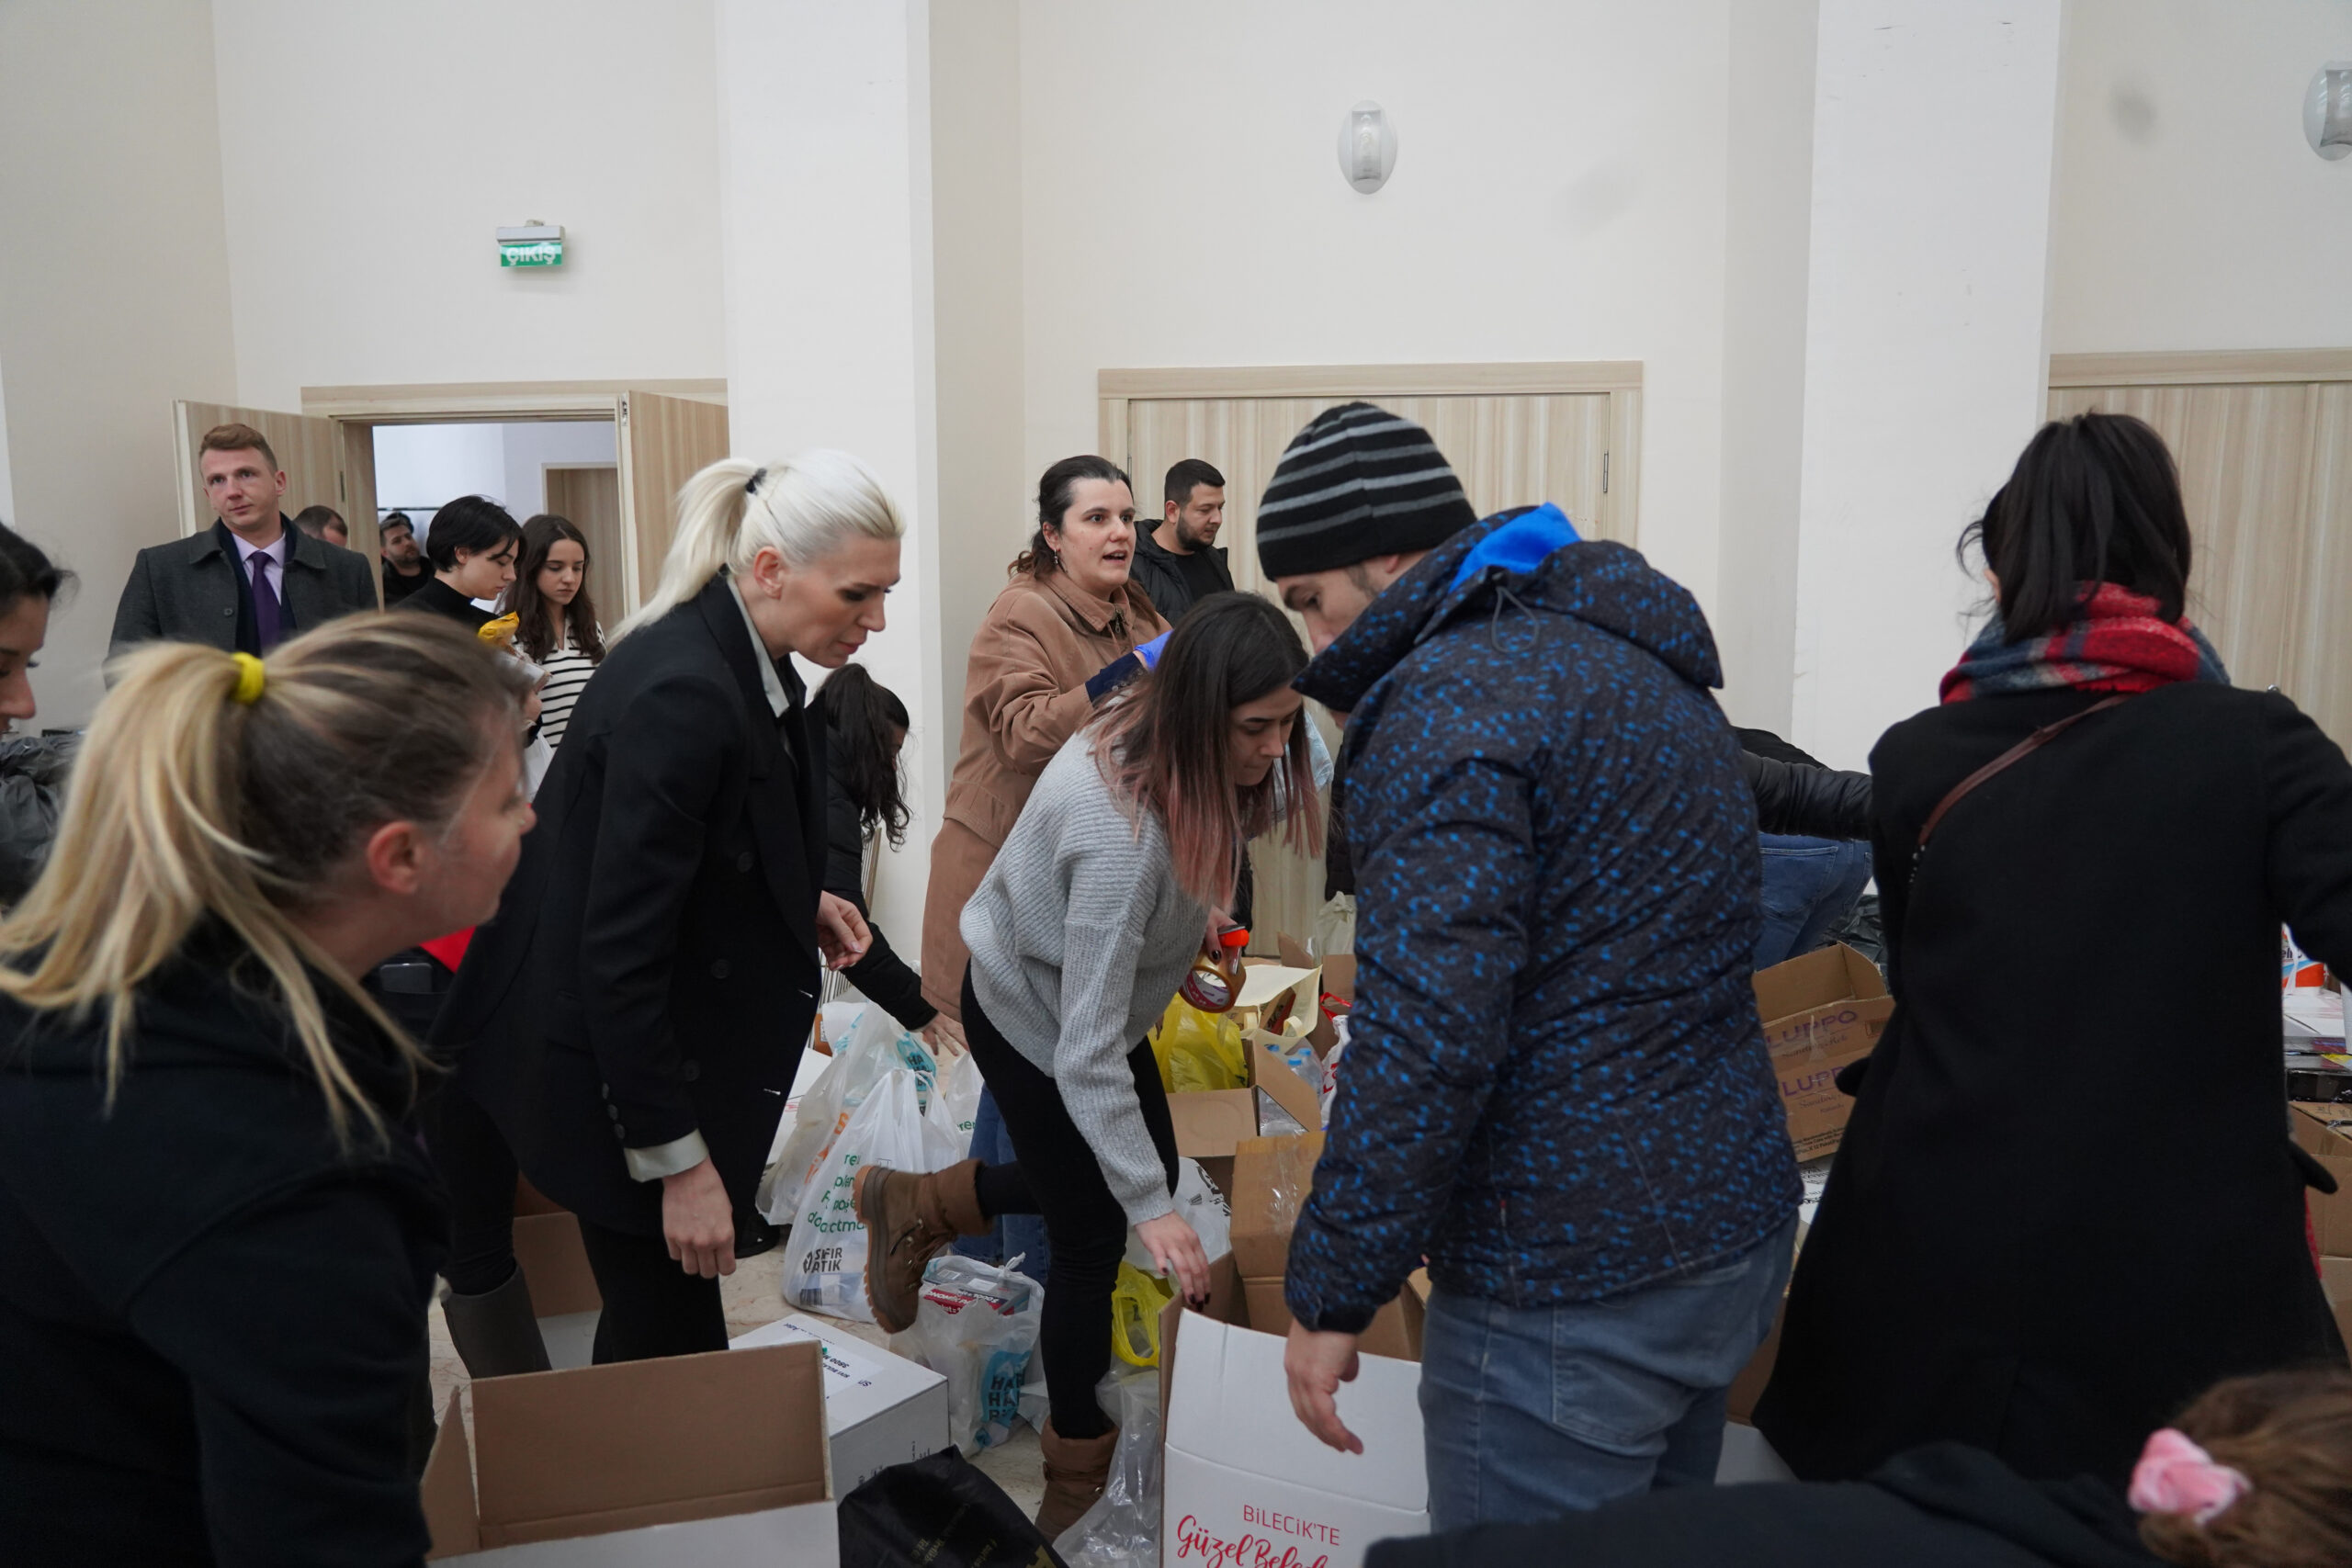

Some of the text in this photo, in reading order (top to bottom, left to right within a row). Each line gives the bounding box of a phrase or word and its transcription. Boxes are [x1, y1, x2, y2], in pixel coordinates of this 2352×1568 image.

[506, 245, 556, 265] ÇIKIŞ
[1766, 1010, 1858, 1049] LUPPO
[1781, 1066, 1847, 1097] LUPP
[810, 1258, 842, 1274] ATIK
[814, 1247, 842, 1261] SIFIR
[1177, 1514, 1254, 1568] Güzel
